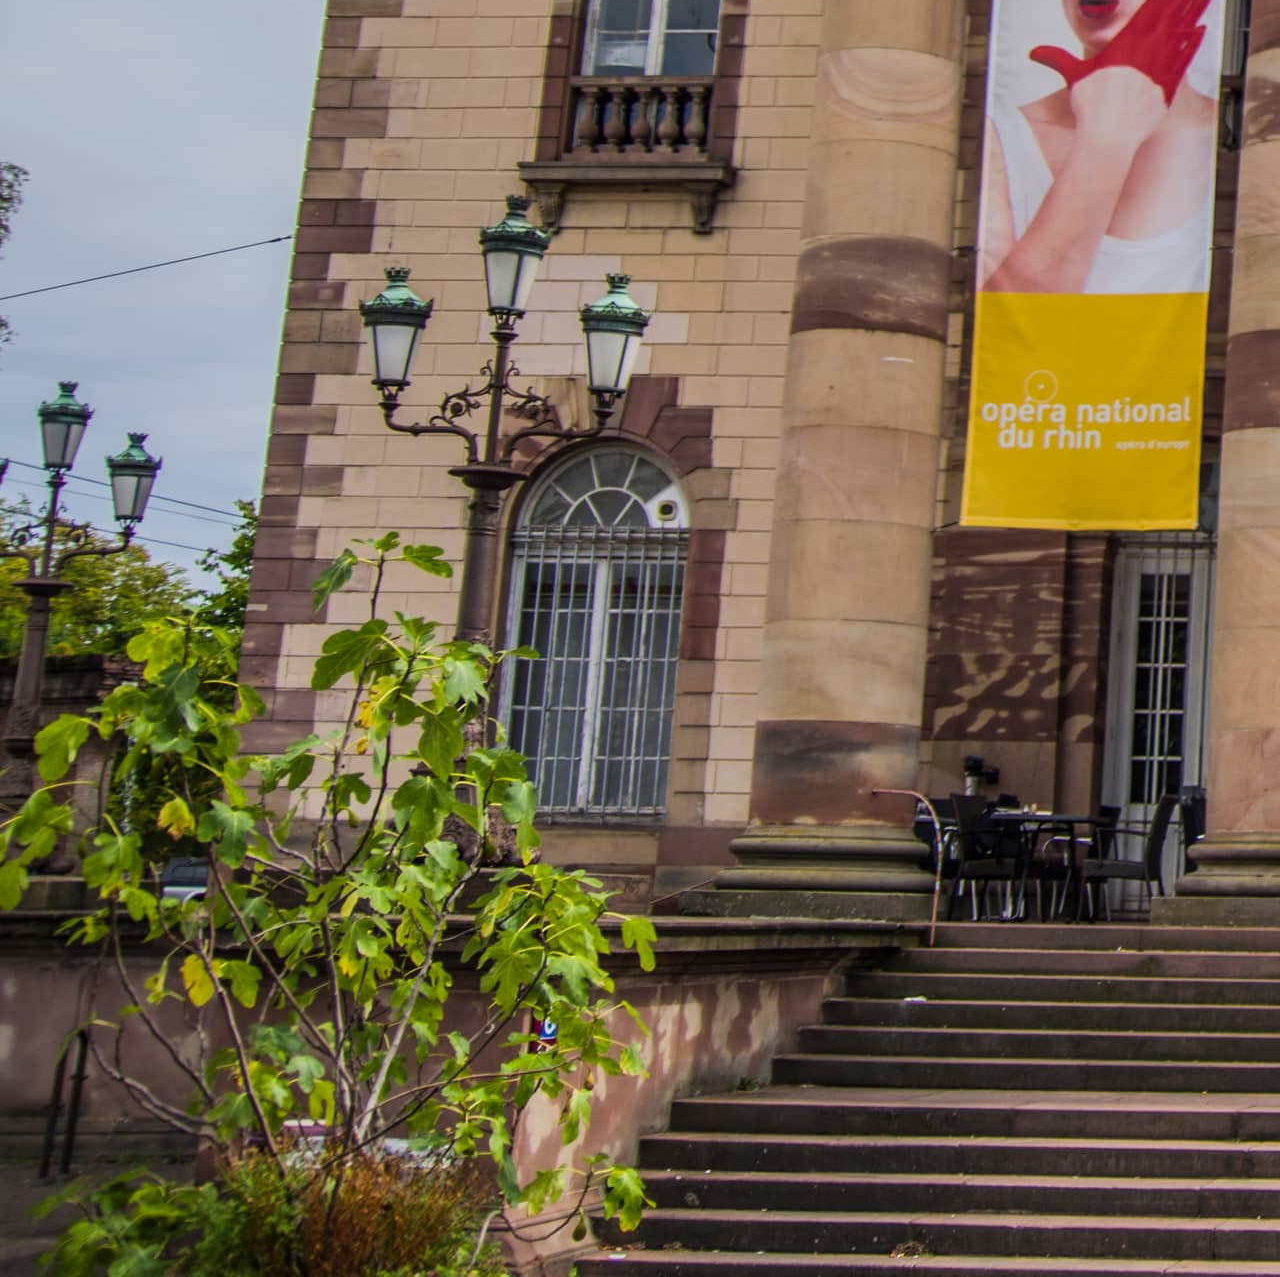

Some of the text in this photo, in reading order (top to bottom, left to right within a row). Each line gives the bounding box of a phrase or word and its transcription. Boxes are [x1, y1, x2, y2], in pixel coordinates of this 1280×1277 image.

[981, 396, 1191, 427] opéra national
[998, 424, 1101, 449] du rhin
